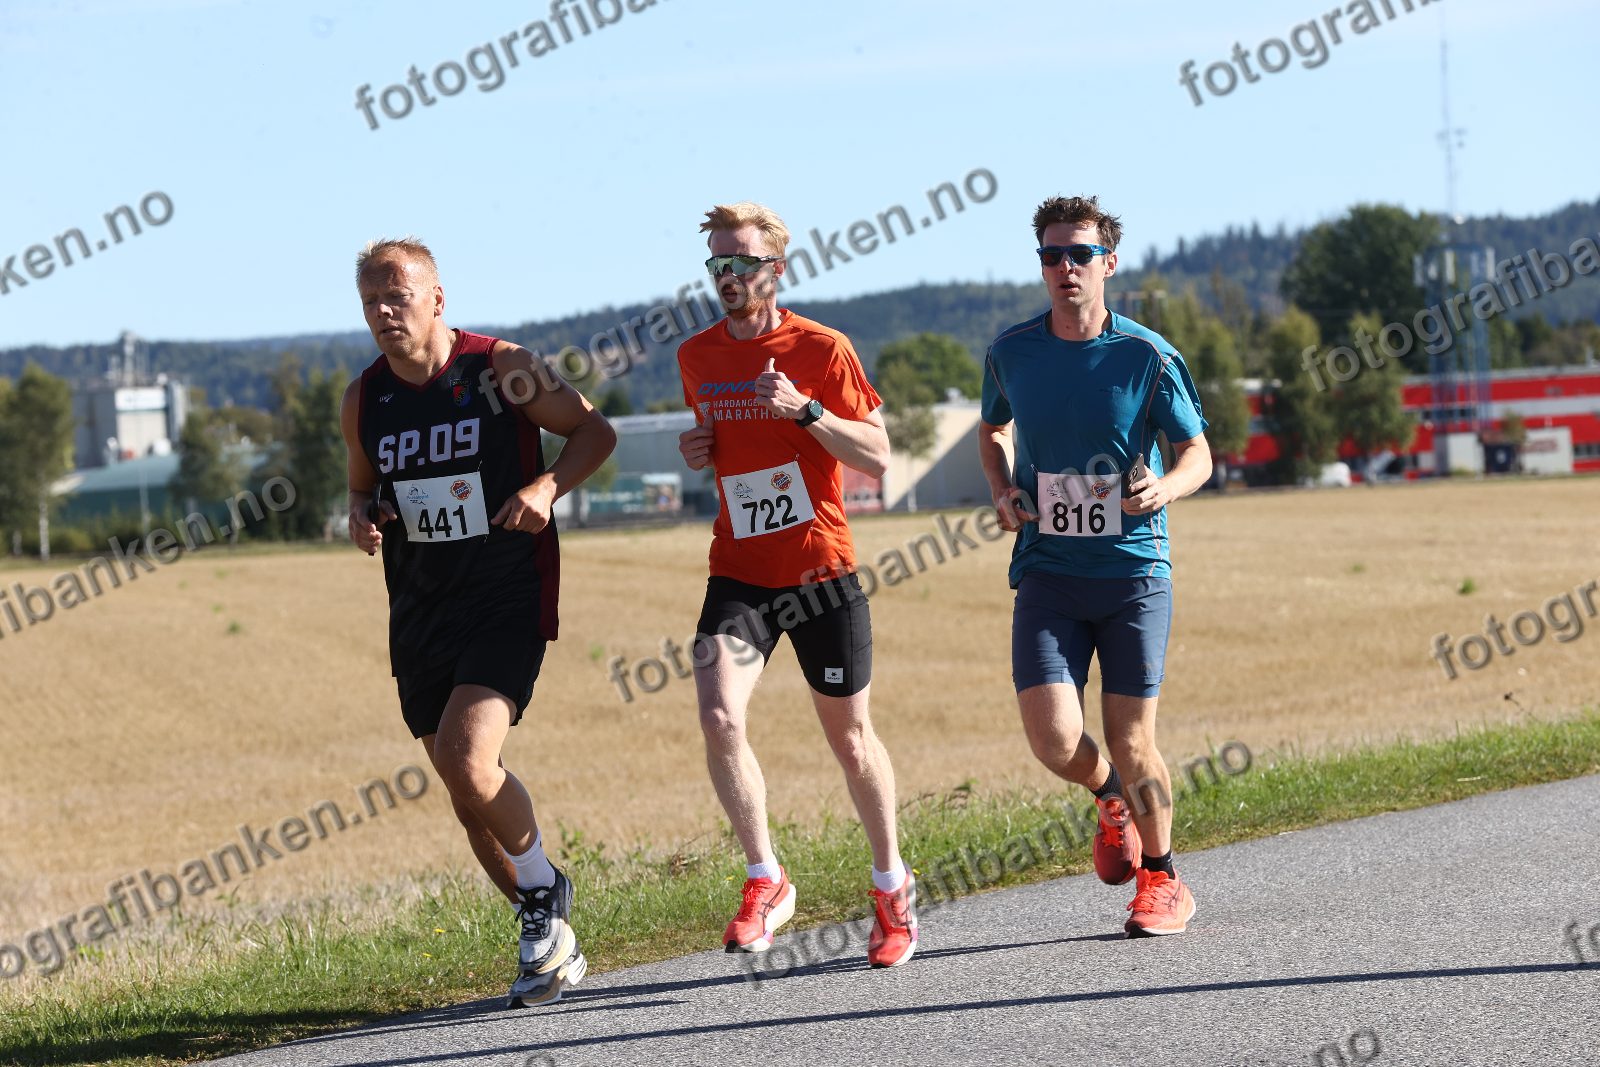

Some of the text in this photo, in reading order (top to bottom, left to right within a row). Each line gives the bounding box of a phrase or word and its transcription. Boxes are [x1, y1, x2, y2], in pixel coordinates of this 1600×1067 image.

[698, 379, 799, 396] DYNA
[713, 398, 760, 408] HARDANGE
[713, 408, 793, 421] MARATHO
[378, 418, 480, 474] SP.09
[417, 504, 468, 539] 441
[742, 494, 799, 534] 722
[1052, 501, 1106, 534] 816
